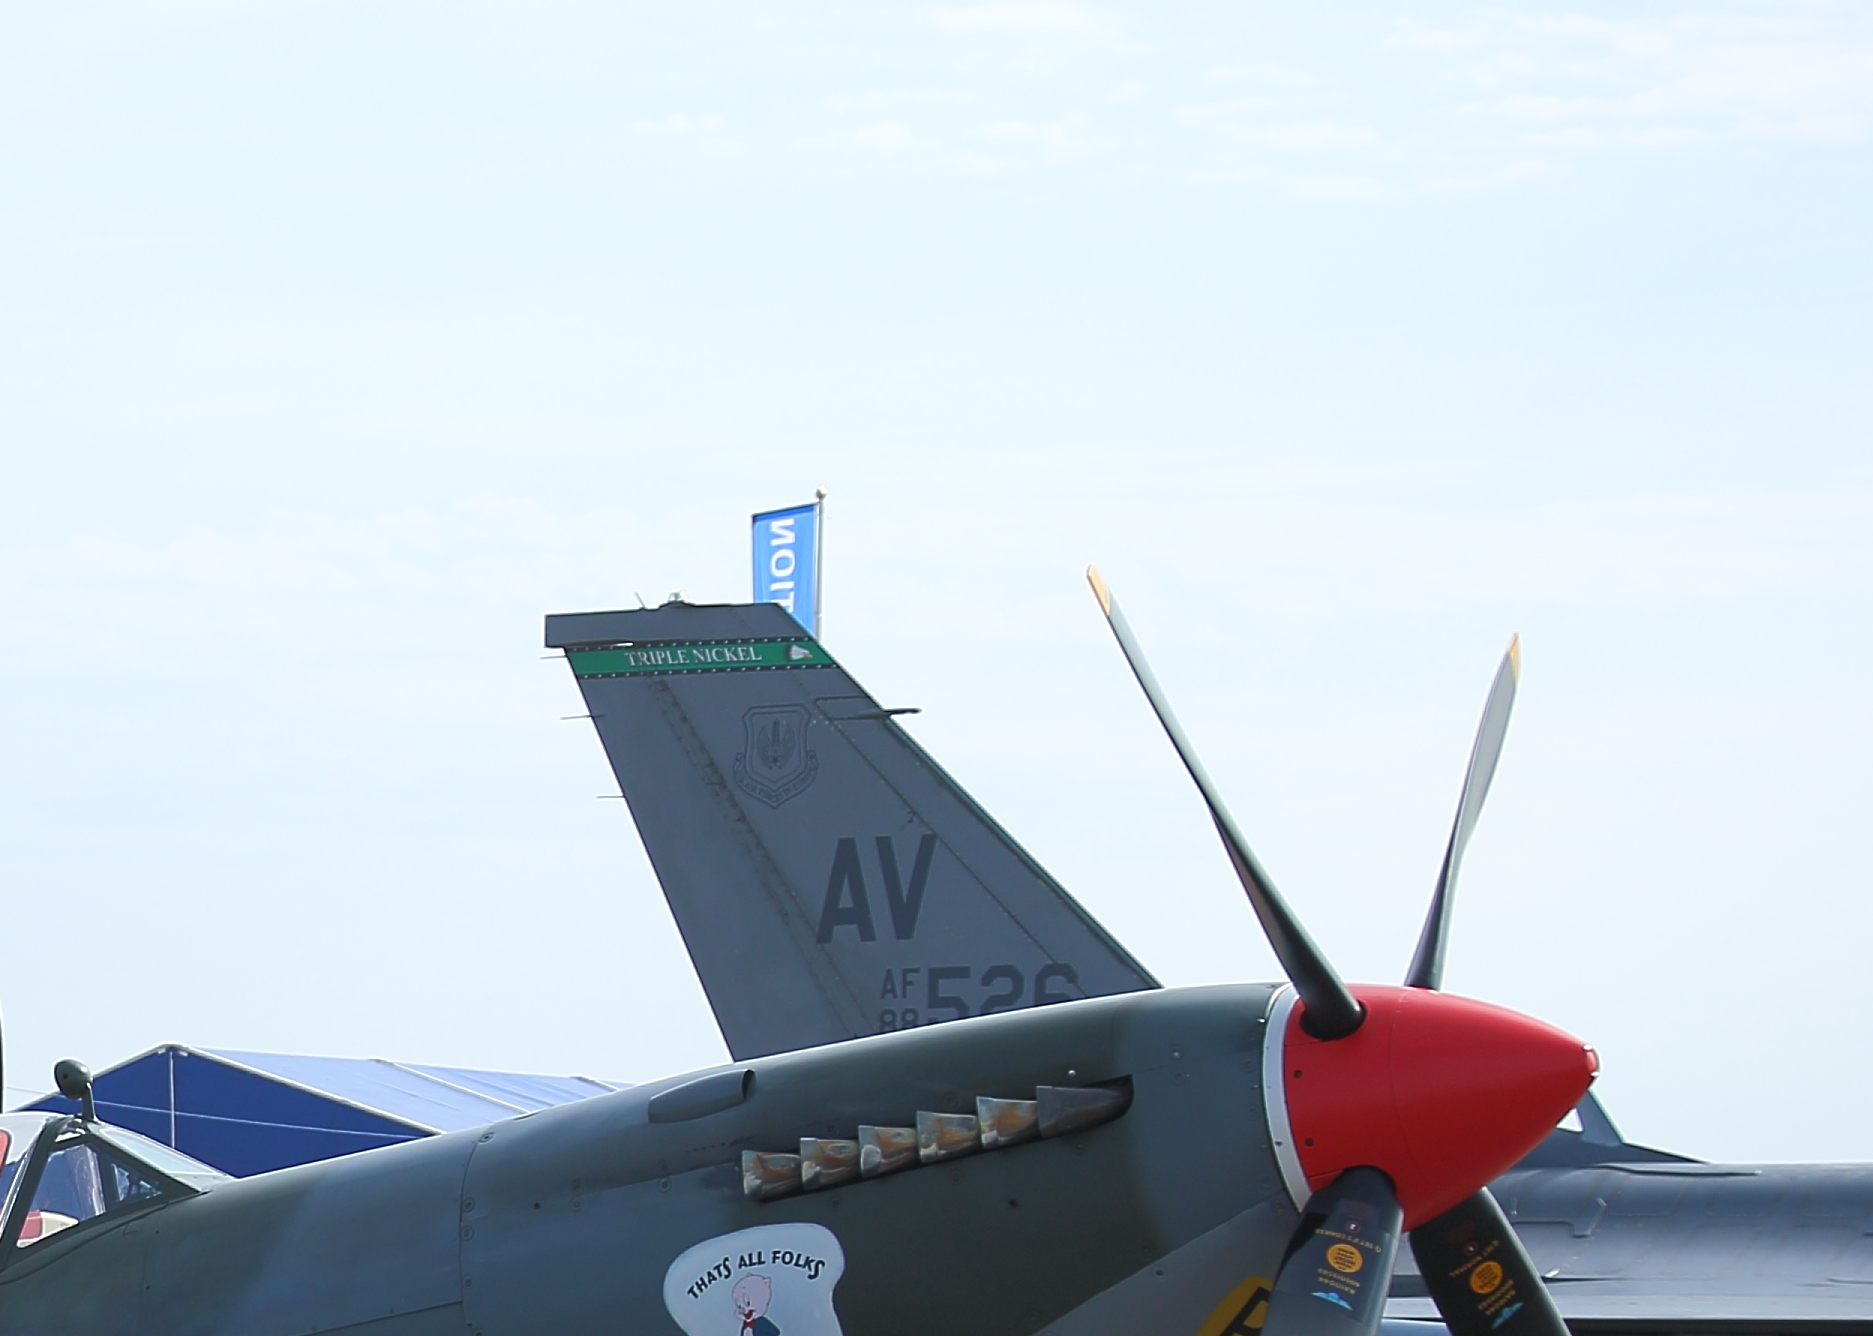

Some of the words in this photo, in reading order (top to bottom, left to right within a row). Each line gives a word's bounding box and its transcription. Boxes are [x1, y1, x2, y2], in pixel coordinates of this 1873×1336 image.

[625, 650, 690, 667] TRIPLE
[692, 647, 763, 662] NICKEL
[816, 833, 938, 944] AV
[881, 967, 921, 999] AF
[738, 1251, 766, 1269] ALL
